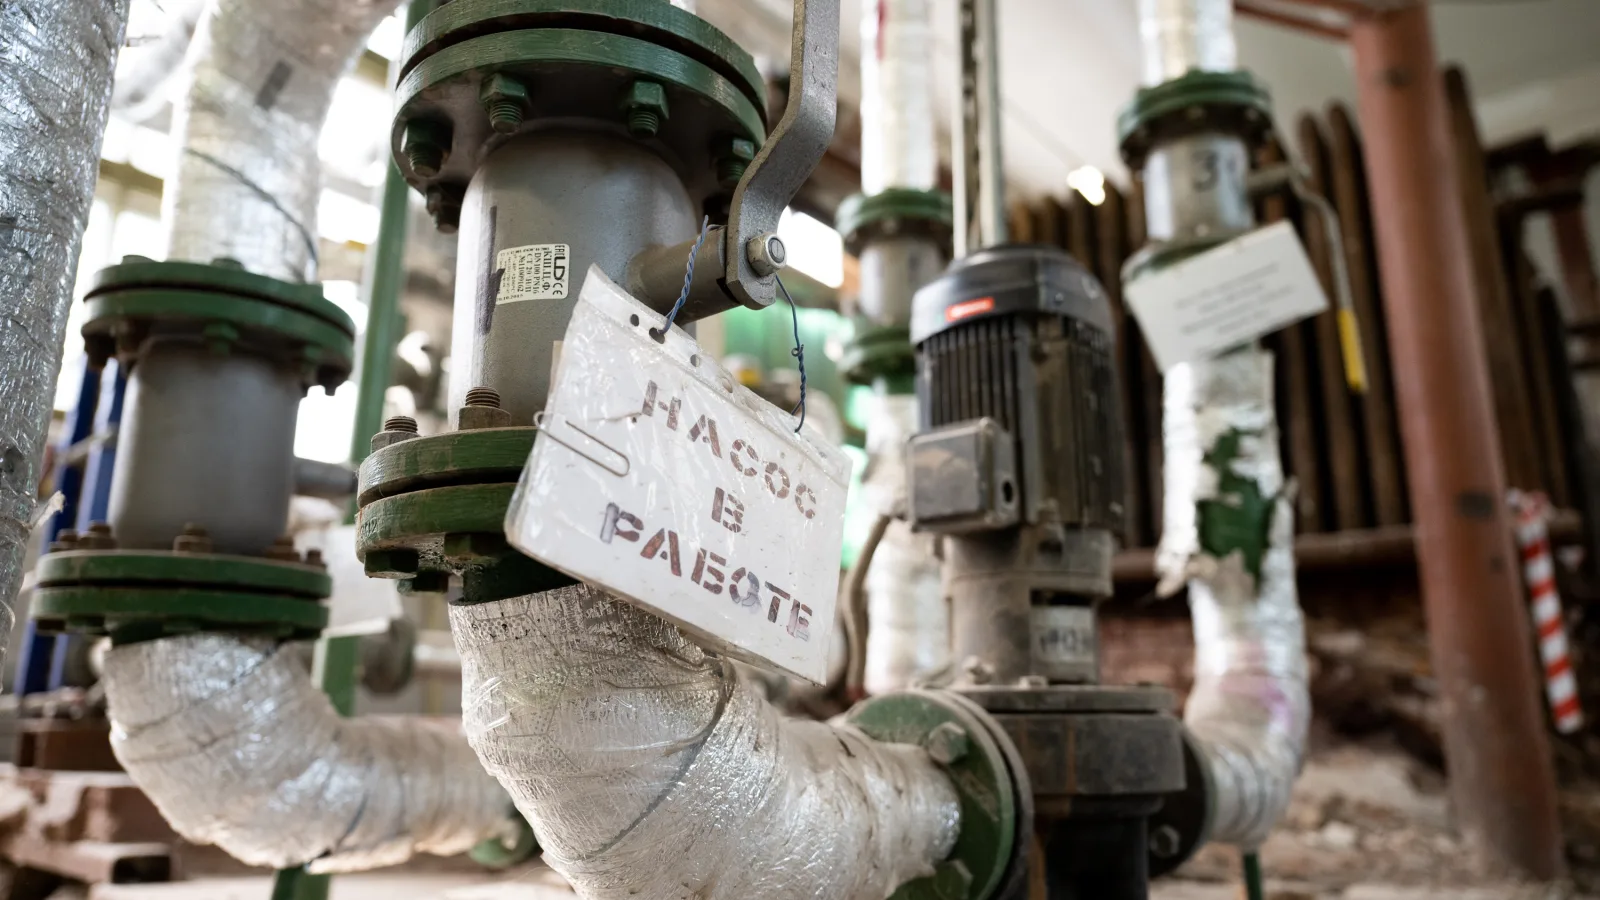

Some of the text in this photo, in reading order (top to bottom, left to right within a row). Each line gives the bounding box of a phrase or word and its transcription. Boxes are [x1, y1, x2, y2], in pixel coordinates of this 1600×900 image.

[641, 379, 817, 520] НАСОС
[711, 486, 744, 533] В
[600, 502, 813, 641] РАБОТЕ
